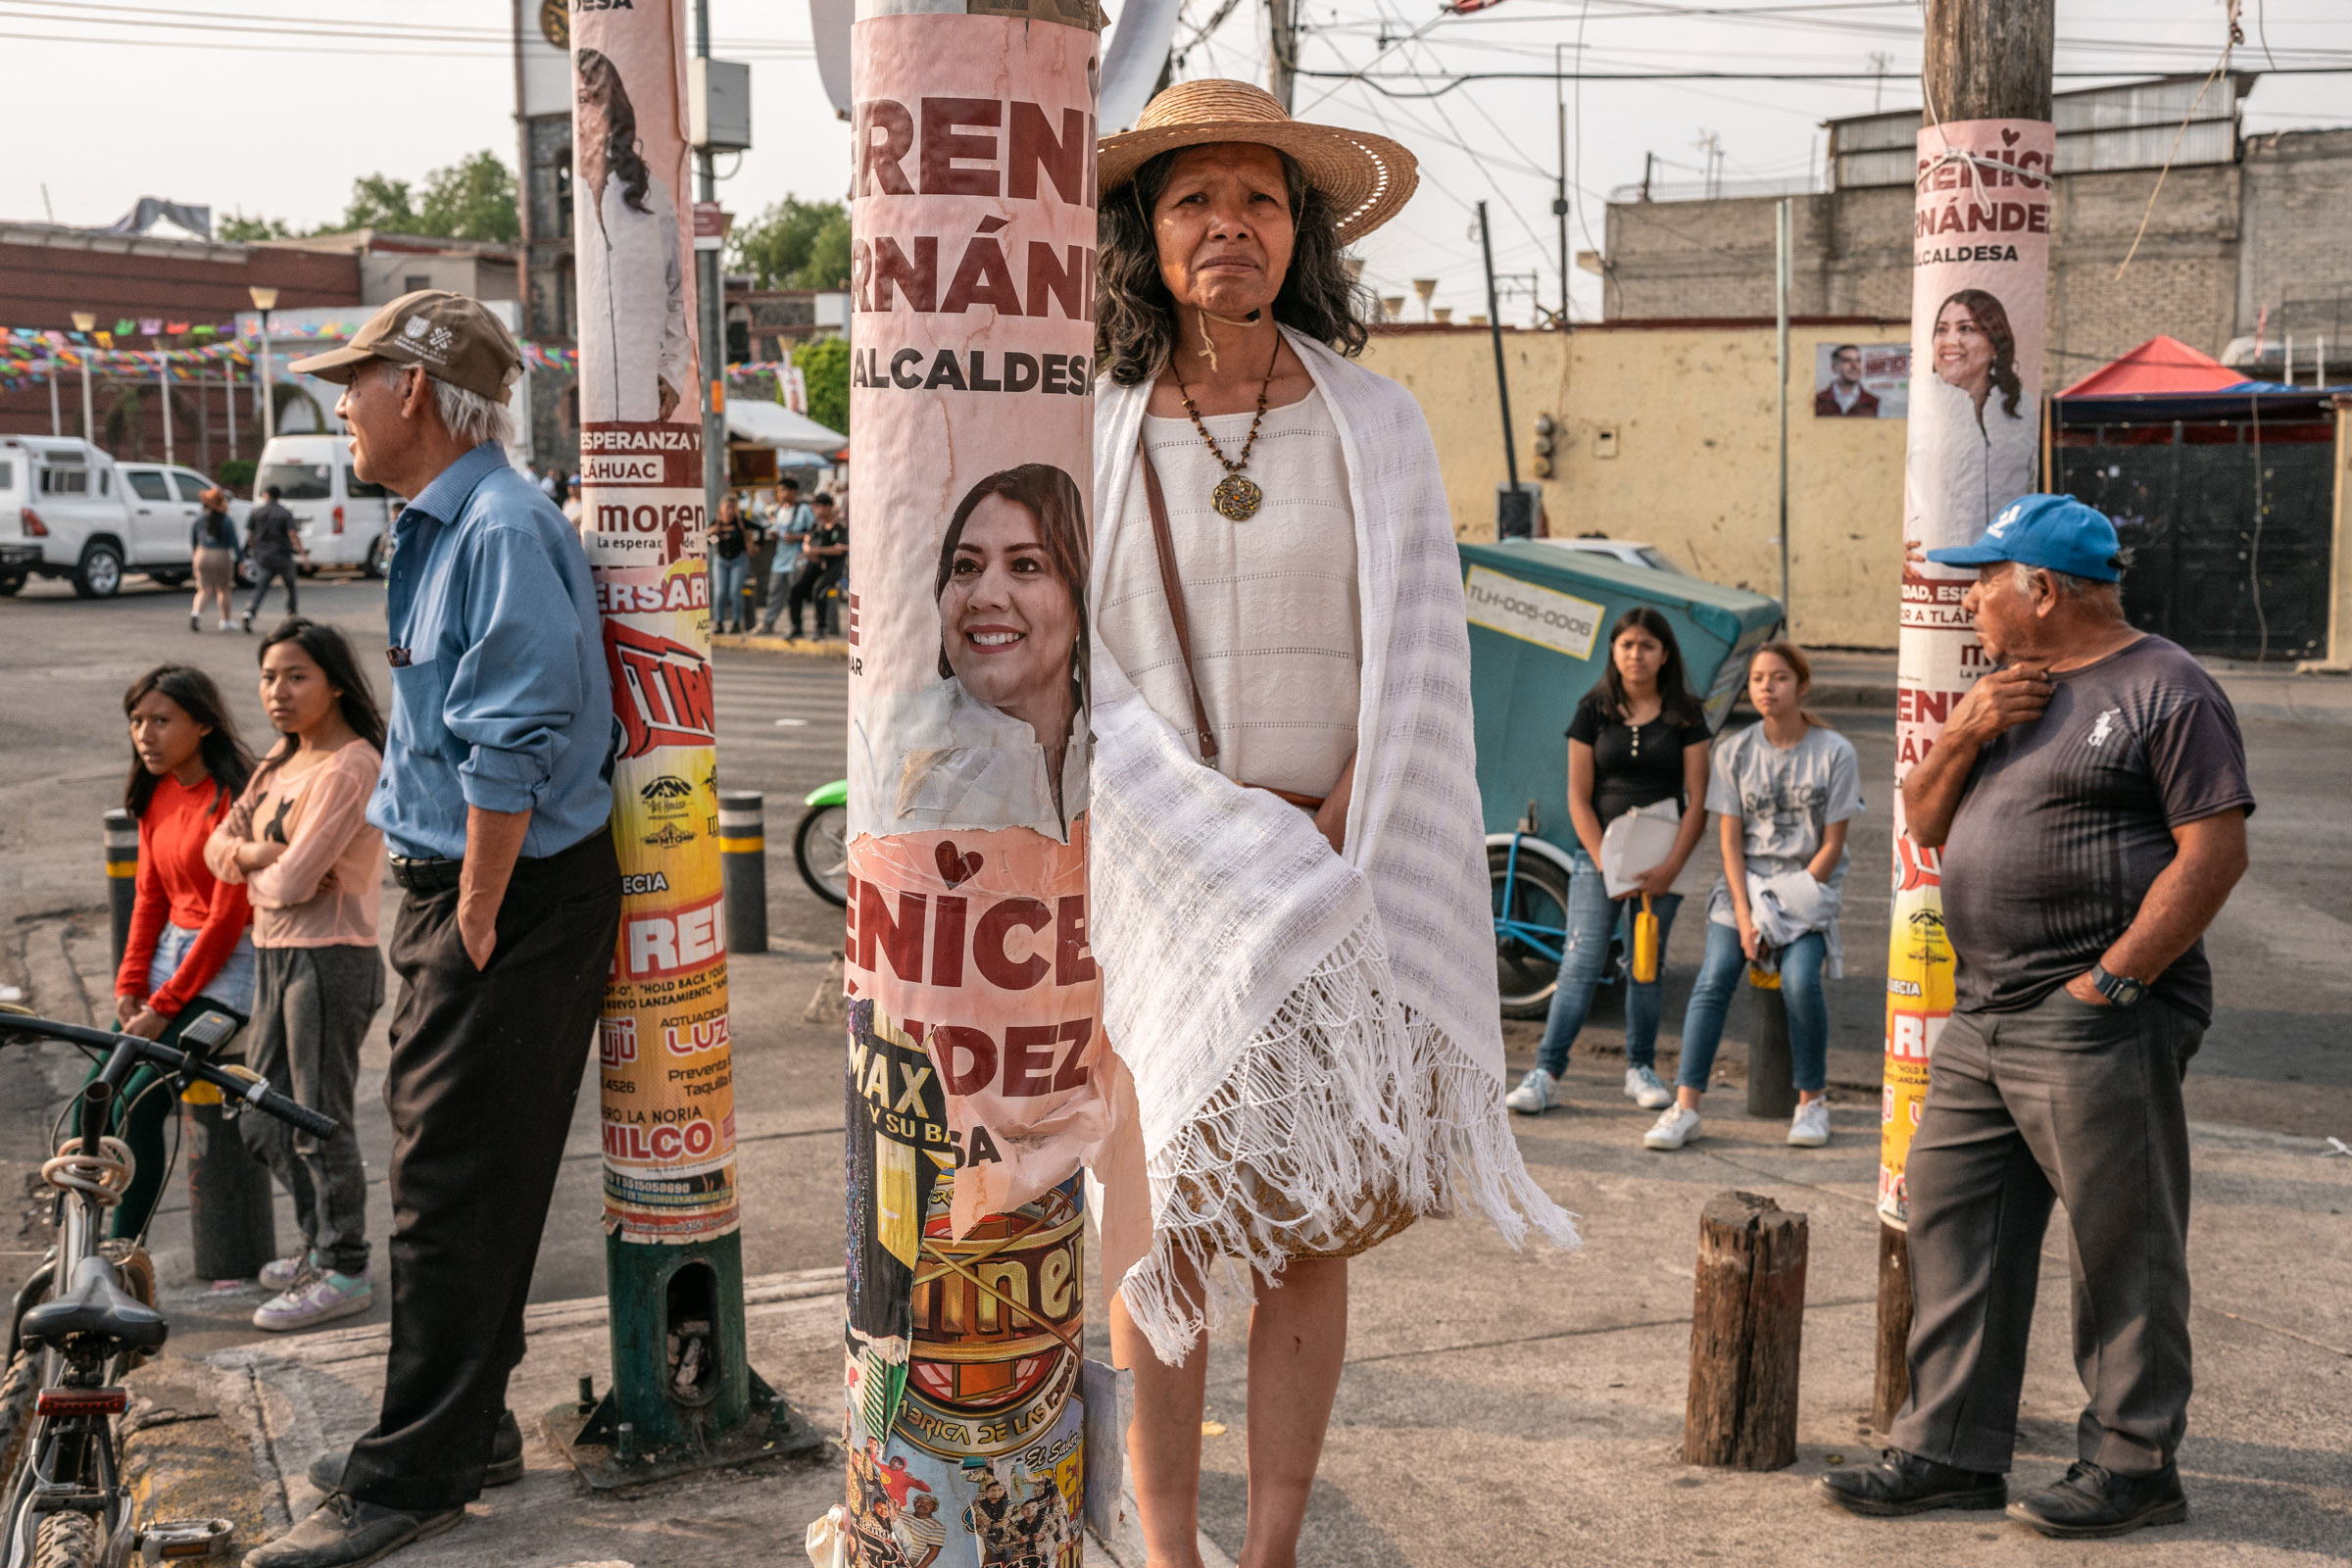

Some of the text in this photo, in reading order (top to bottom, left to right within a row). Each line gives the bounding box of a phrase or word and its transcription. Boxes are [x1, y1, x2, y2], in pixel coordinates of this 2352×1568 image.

[678, 973, 706, 990] BACK
[848, 1030, 932, 1120] MAX
[627, 1109, 646, 1124] LA
[652, 1105, 703, 1124] NORIA
[886, 1113, 916, 1139] SU
